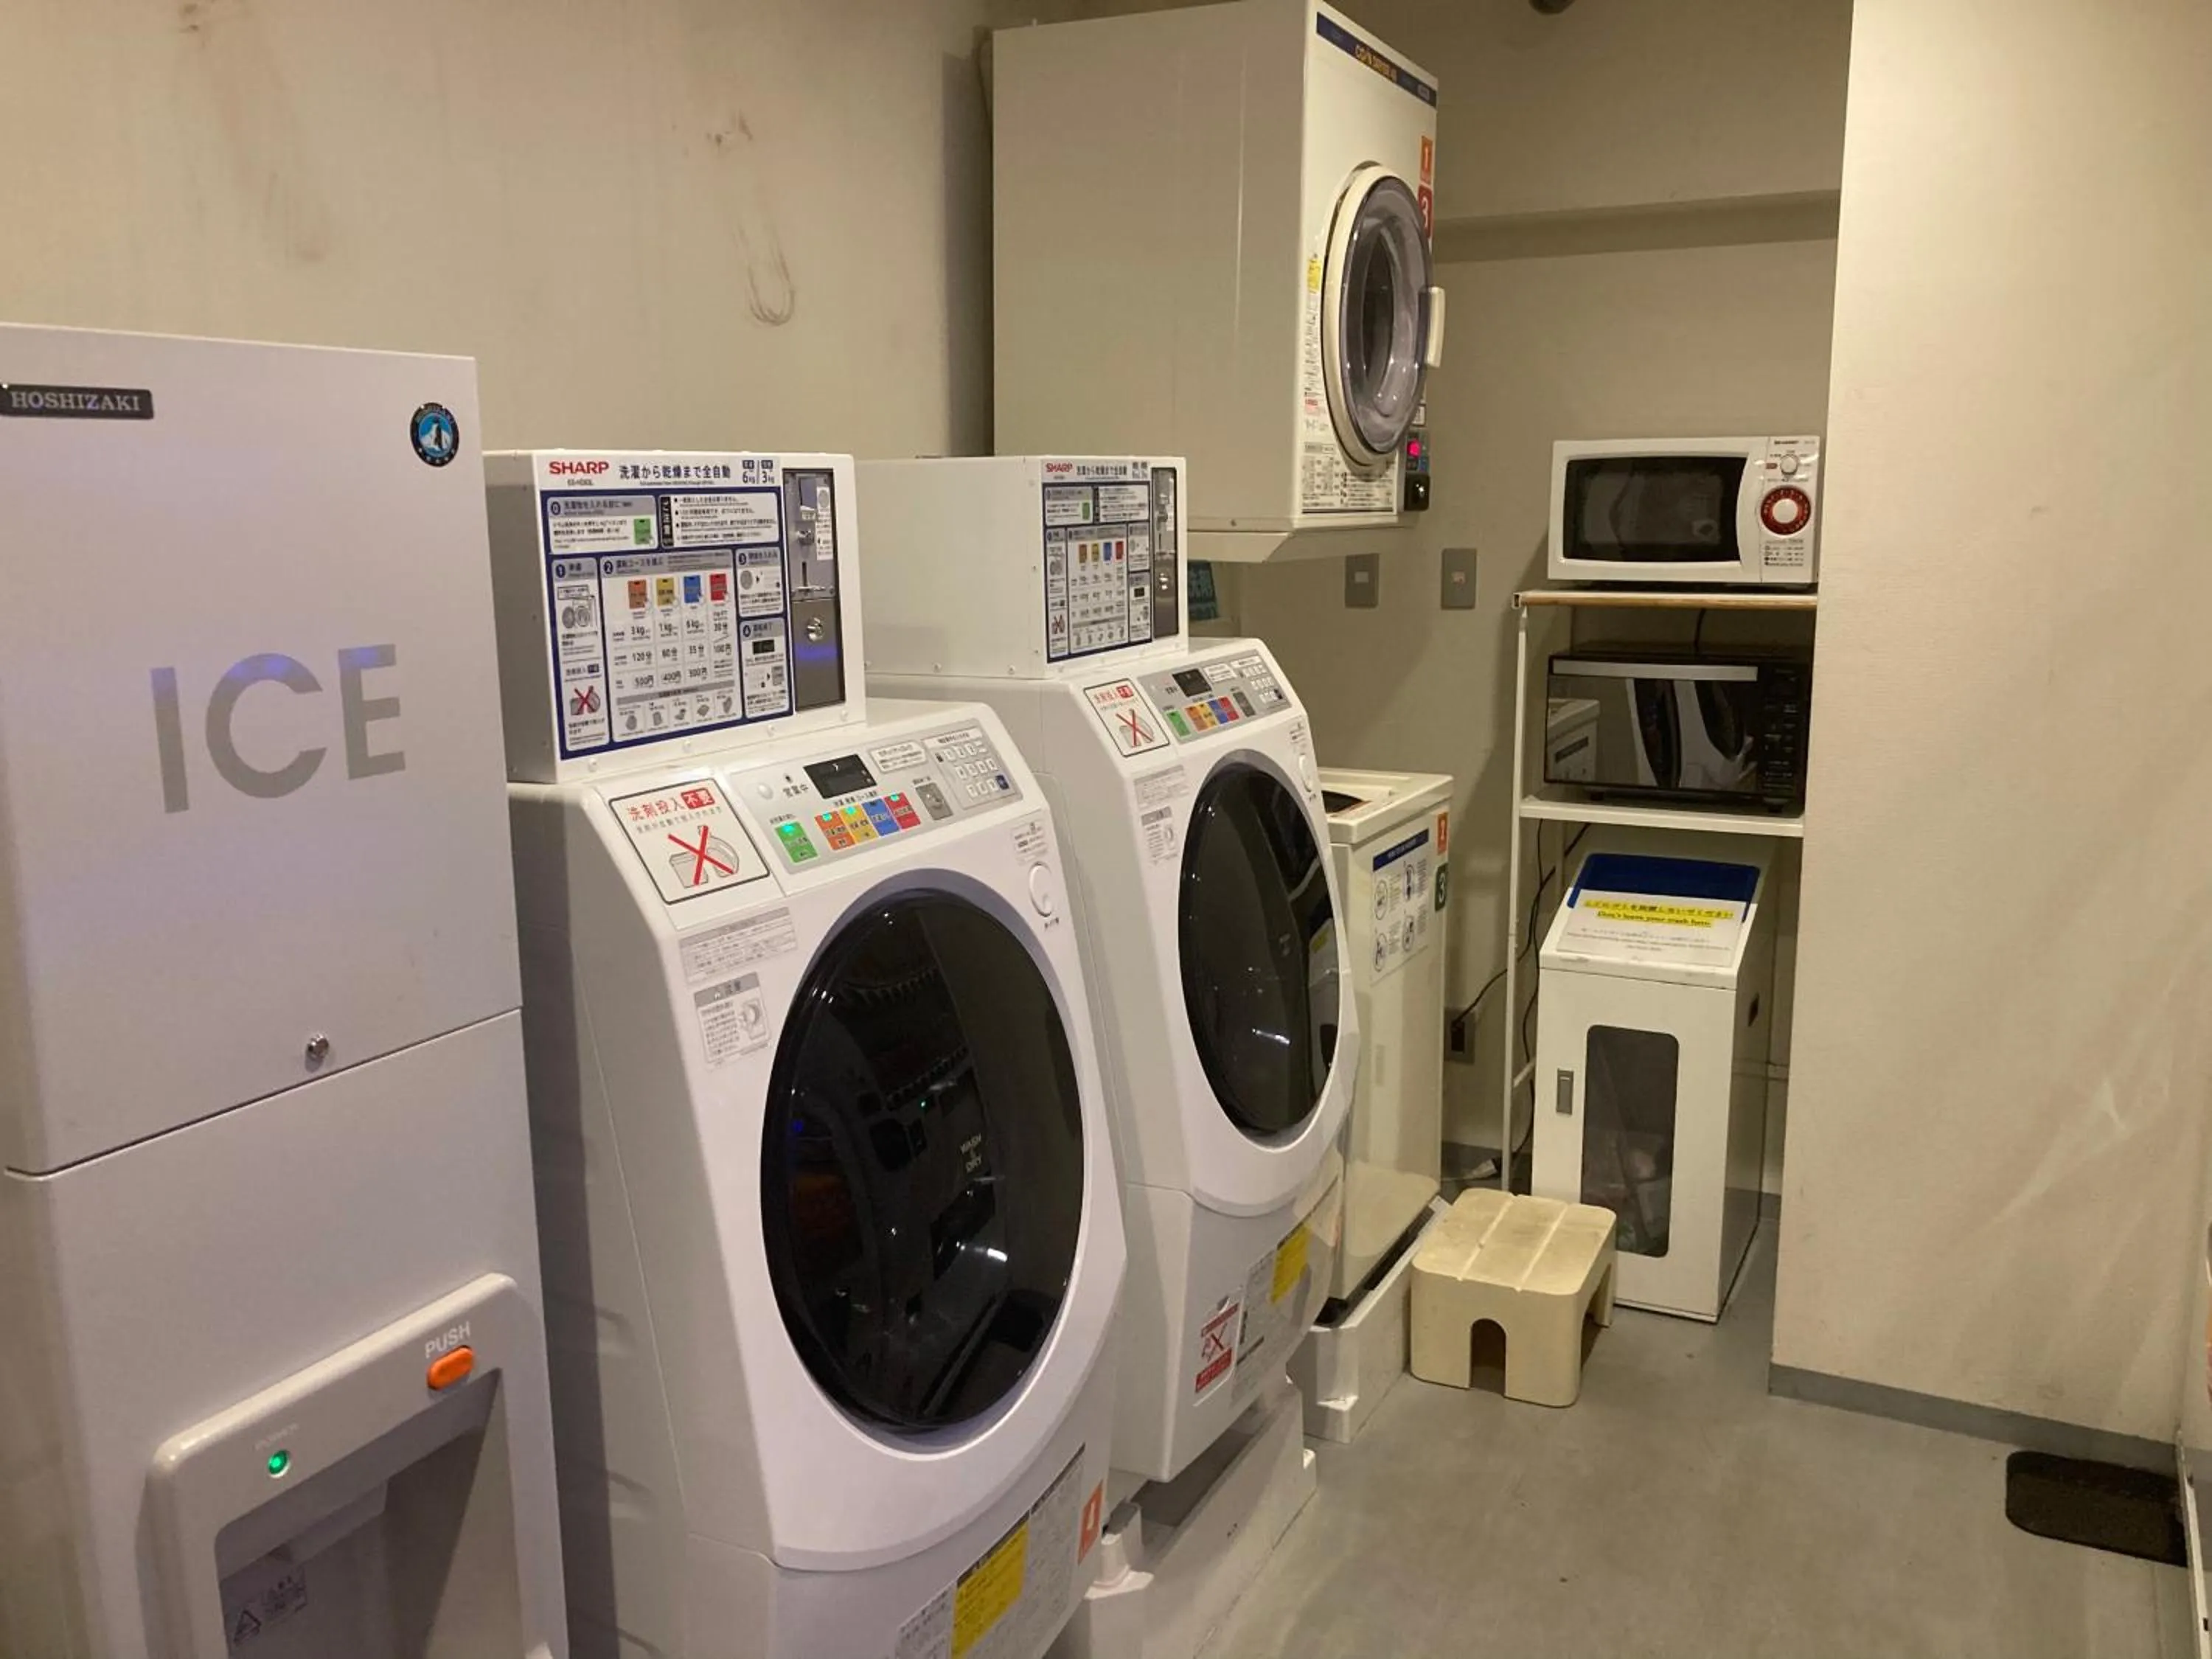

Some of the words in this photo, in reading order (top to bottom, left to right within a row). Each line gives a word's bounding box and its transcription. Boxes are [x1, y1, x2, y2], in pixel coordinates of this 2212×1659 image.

[1421, 196, 1429, 229] 3
[10, 392, 142, 411] HOSHIZAKI
[549, 461, 610, 474] SHARP
[619, 465, 731, 479] 洗濯から乾燥まで全自動
[1045, 462, 1074, 473] SHARP
[150, 644, 406, 814] ICE
[1438, 872, 1445, 903] 3
[425, 1321, 470, 1359] PUSH
